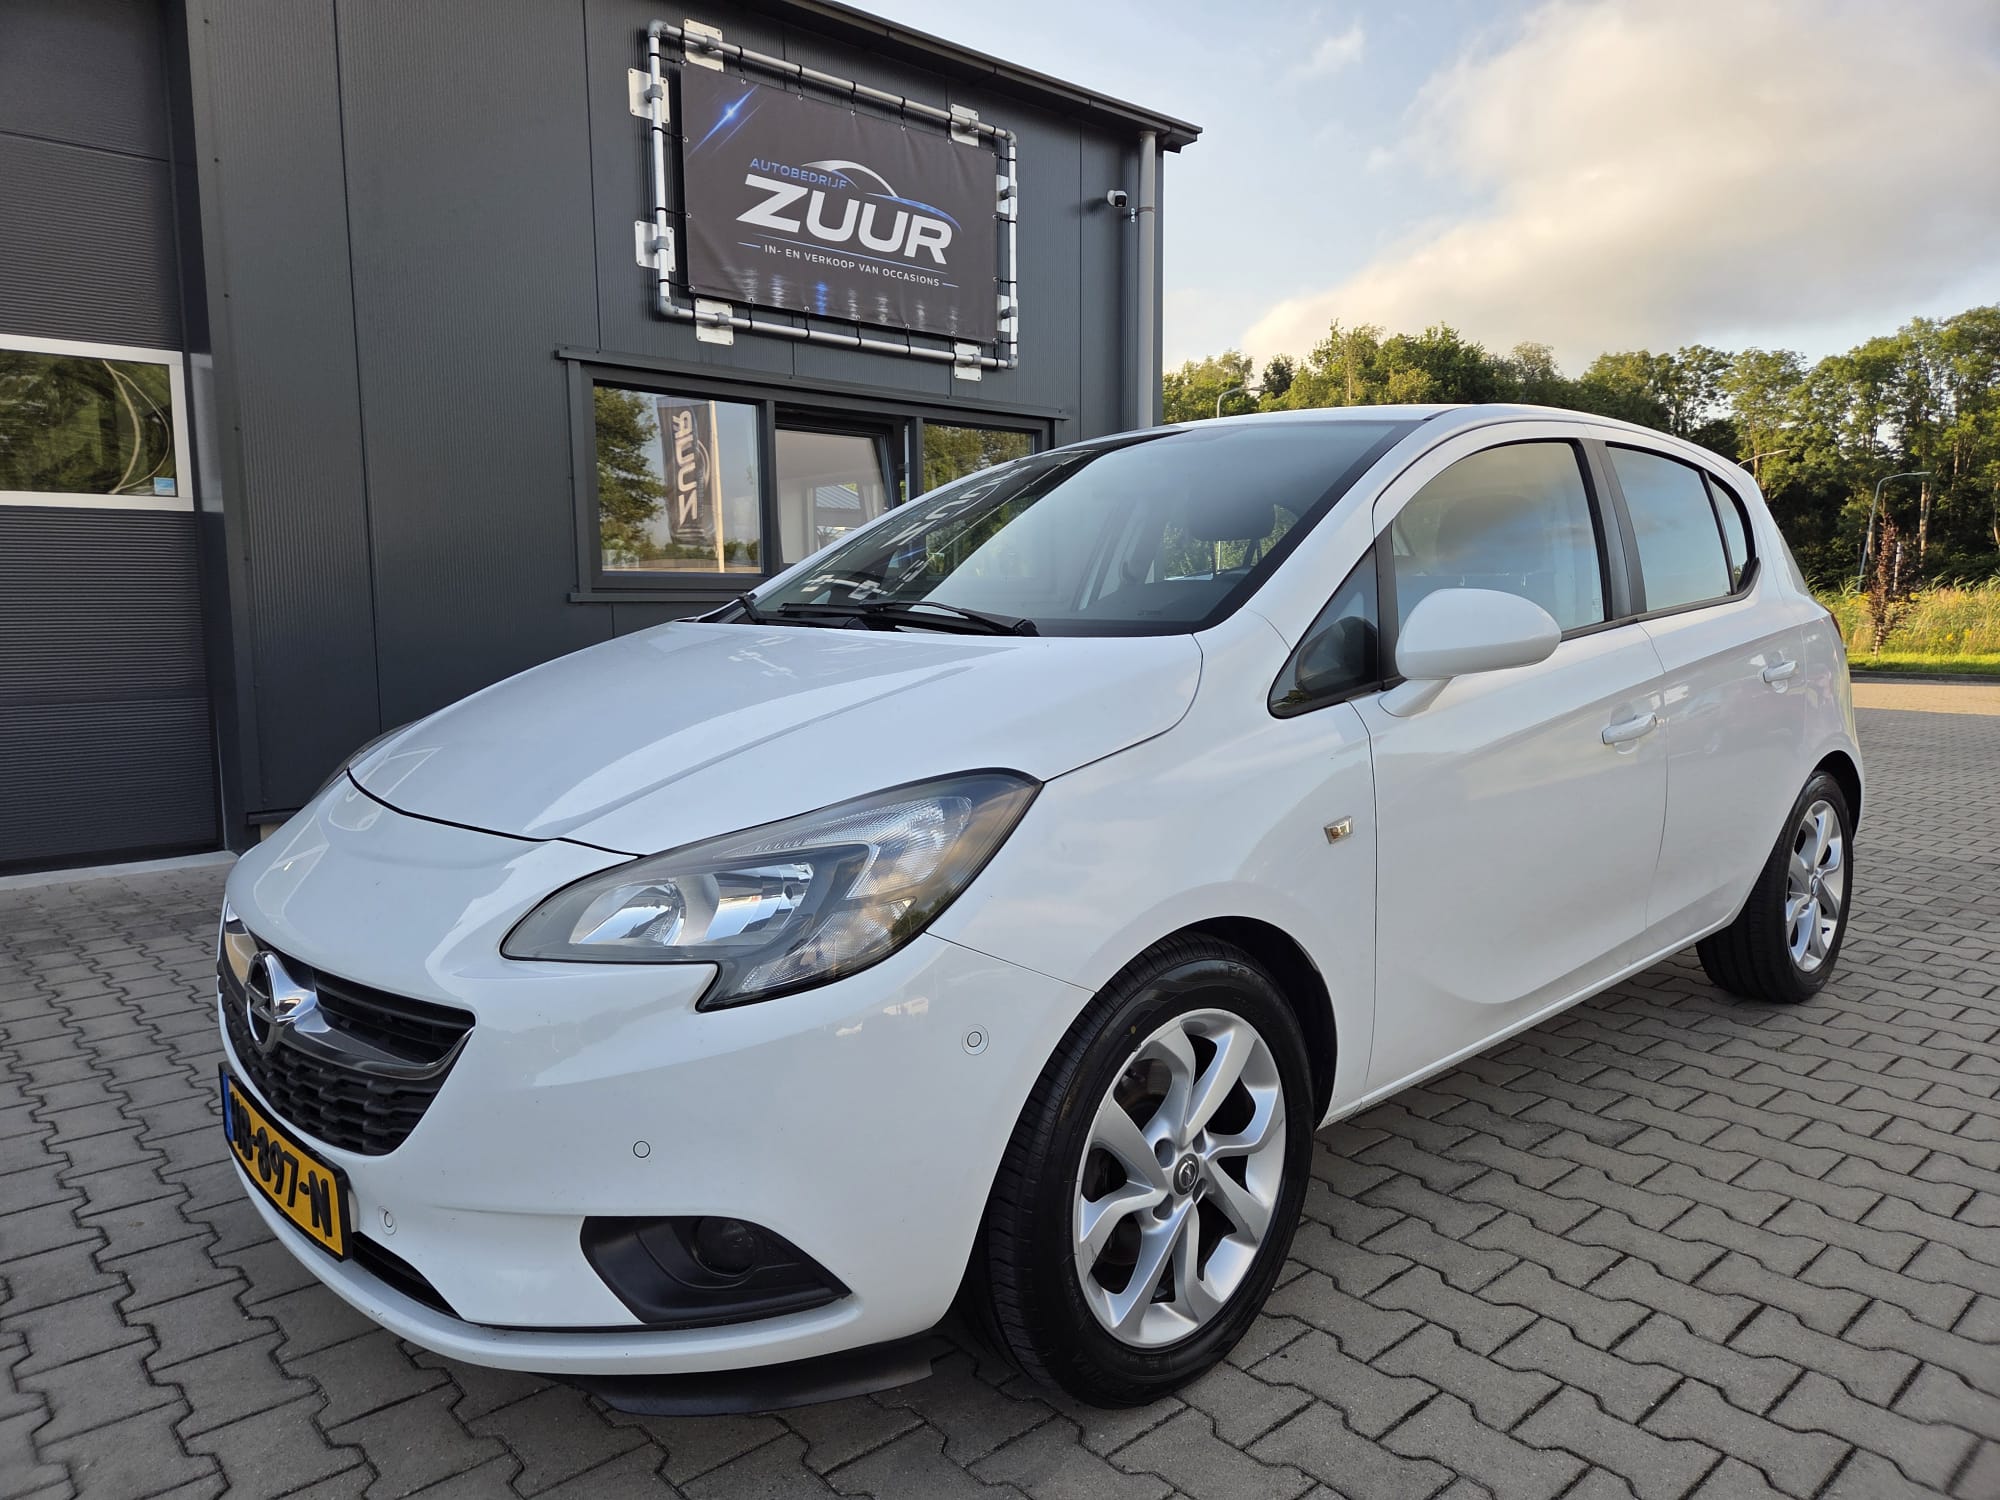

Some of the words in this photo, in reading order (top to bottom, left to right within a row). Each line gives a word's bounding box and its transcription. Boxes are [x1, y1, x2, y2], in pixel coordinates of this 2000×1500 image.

[750, 158, 848, 190] AUTOBEDRIJF
[736, 173, 953, 265] ZUUR
[764, 244, 782, 255] IN-
[785, 248, 801, 260] EN
[804, 252, 856, 270] VERKOOP
[858, 264, 880, 275] VAN
[882, 268, 940, 287] OCCASIONS
